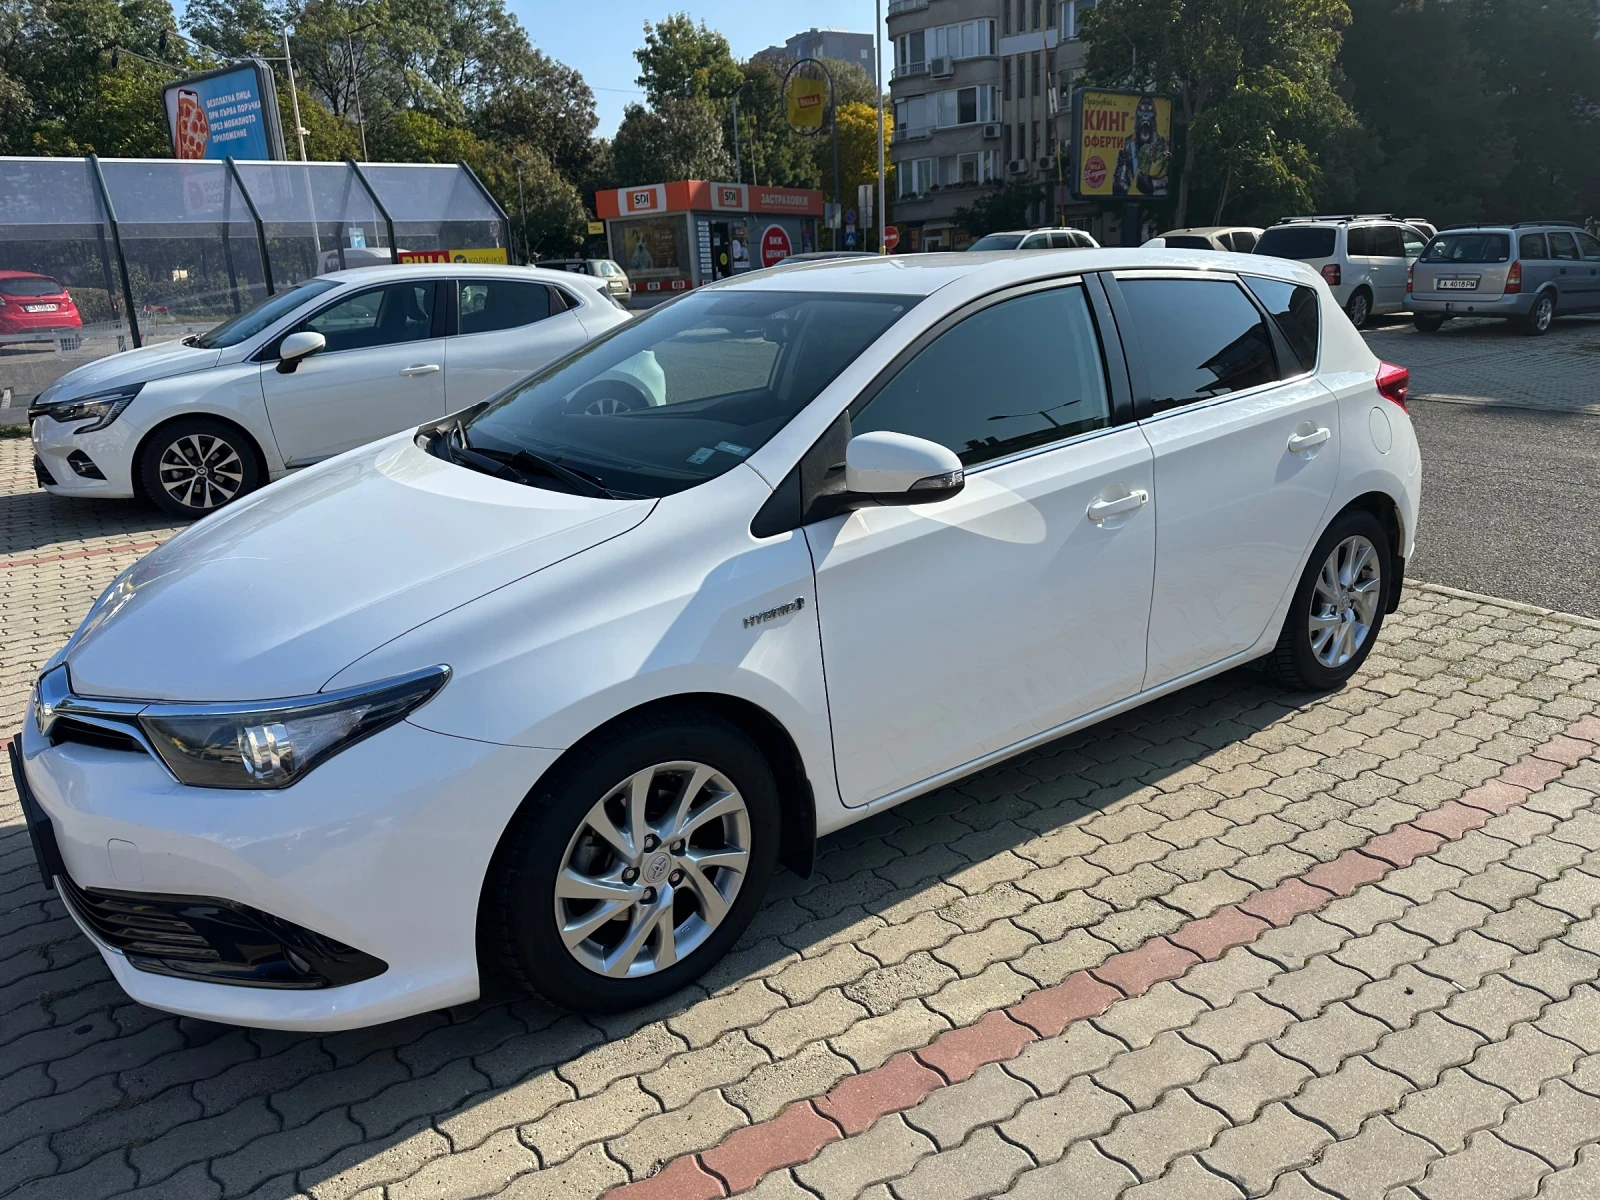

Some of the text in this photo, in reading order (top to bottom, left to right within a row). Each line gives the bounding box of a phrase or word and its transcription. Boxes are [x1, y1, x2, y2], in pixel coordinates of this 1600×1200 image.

[206, 90, 251, 108] БЕЗПЛАТНА ПИЦА
[800, 96, 820, 107] BILLA
[208, 100, 261, 120] ПРИ ПЪРВА ПОРЪЧКА
[210, 114, 256, 132] ПРЕЗ МОБИЛНОТО
[1084, 109, 1130, 132] КИНГ
[212, 128, 248, 143] ПРИЛОЖЕНИЕ
[1084, 134, 1124, 148] ОФЕРТИ
[634, 193, 649, 205] SDI
[724, 190, 736, 201] SDI
[761, 193, 809, 205] ЗАСТРАХОВКИ
[769, 236, 783, 245] ВИЖ
[766, 250, 788, 258] ЦЕНИТЕ
[743, 601, 796, 629] HYBRID
